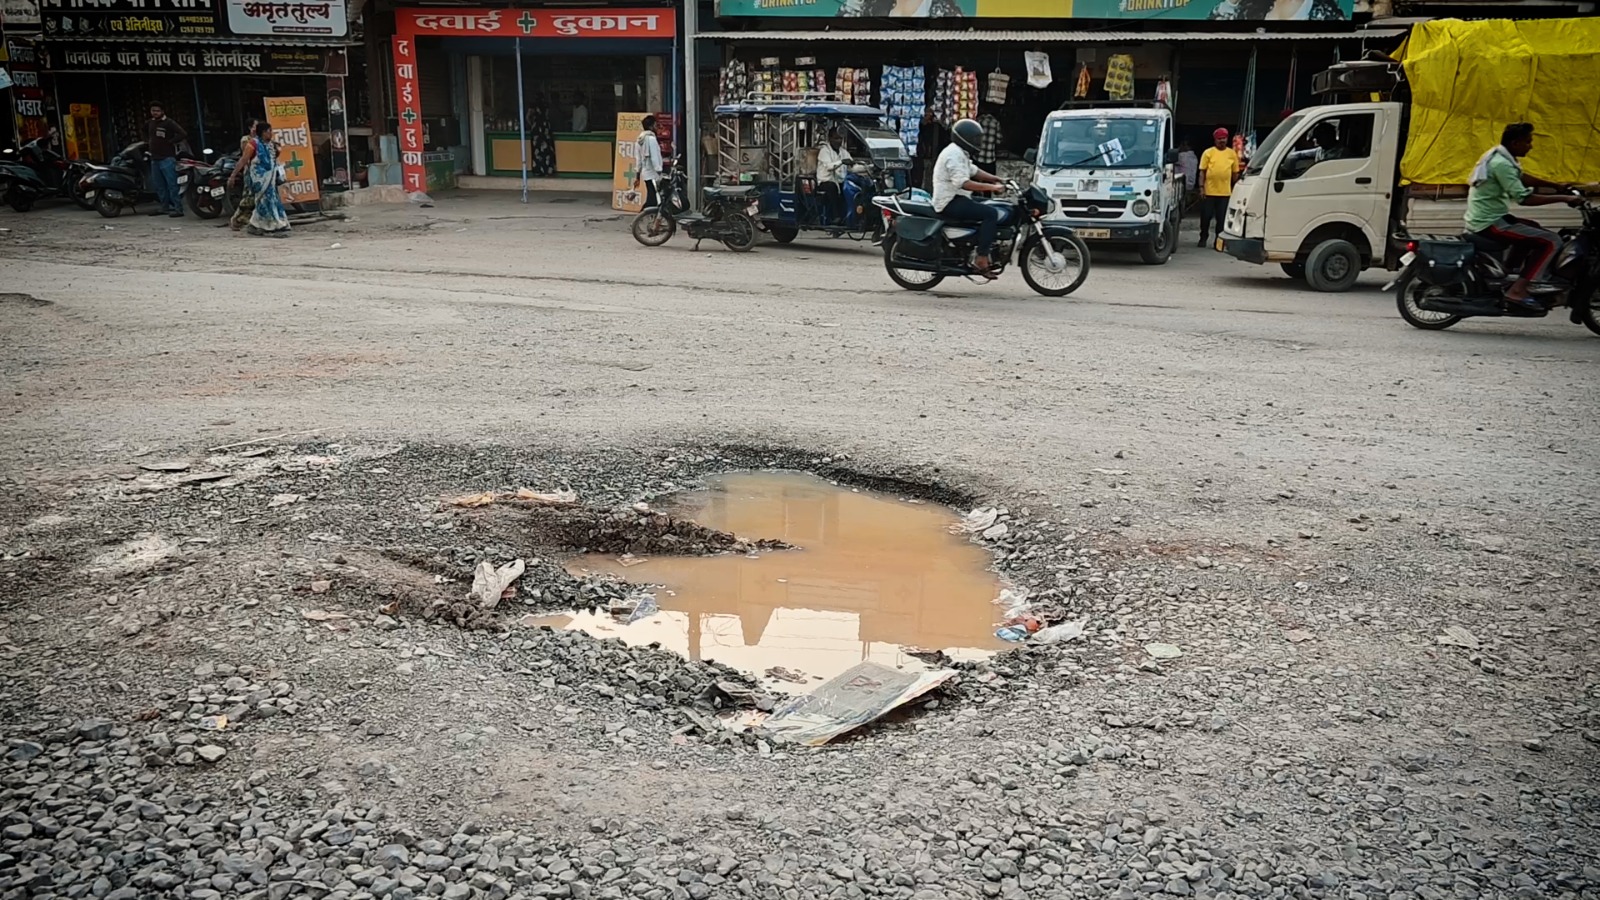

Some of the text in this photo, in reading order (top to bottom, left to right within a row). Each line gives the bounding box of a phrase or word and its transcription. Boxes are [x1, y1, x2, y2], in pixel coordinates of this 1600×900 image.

[413, 10, 660, 35] दवाई दुकान
[117, 52, 140, 66] पान
[146, 49, 171, 66] शॉप
[272, 122, 308, 148] दवाई
